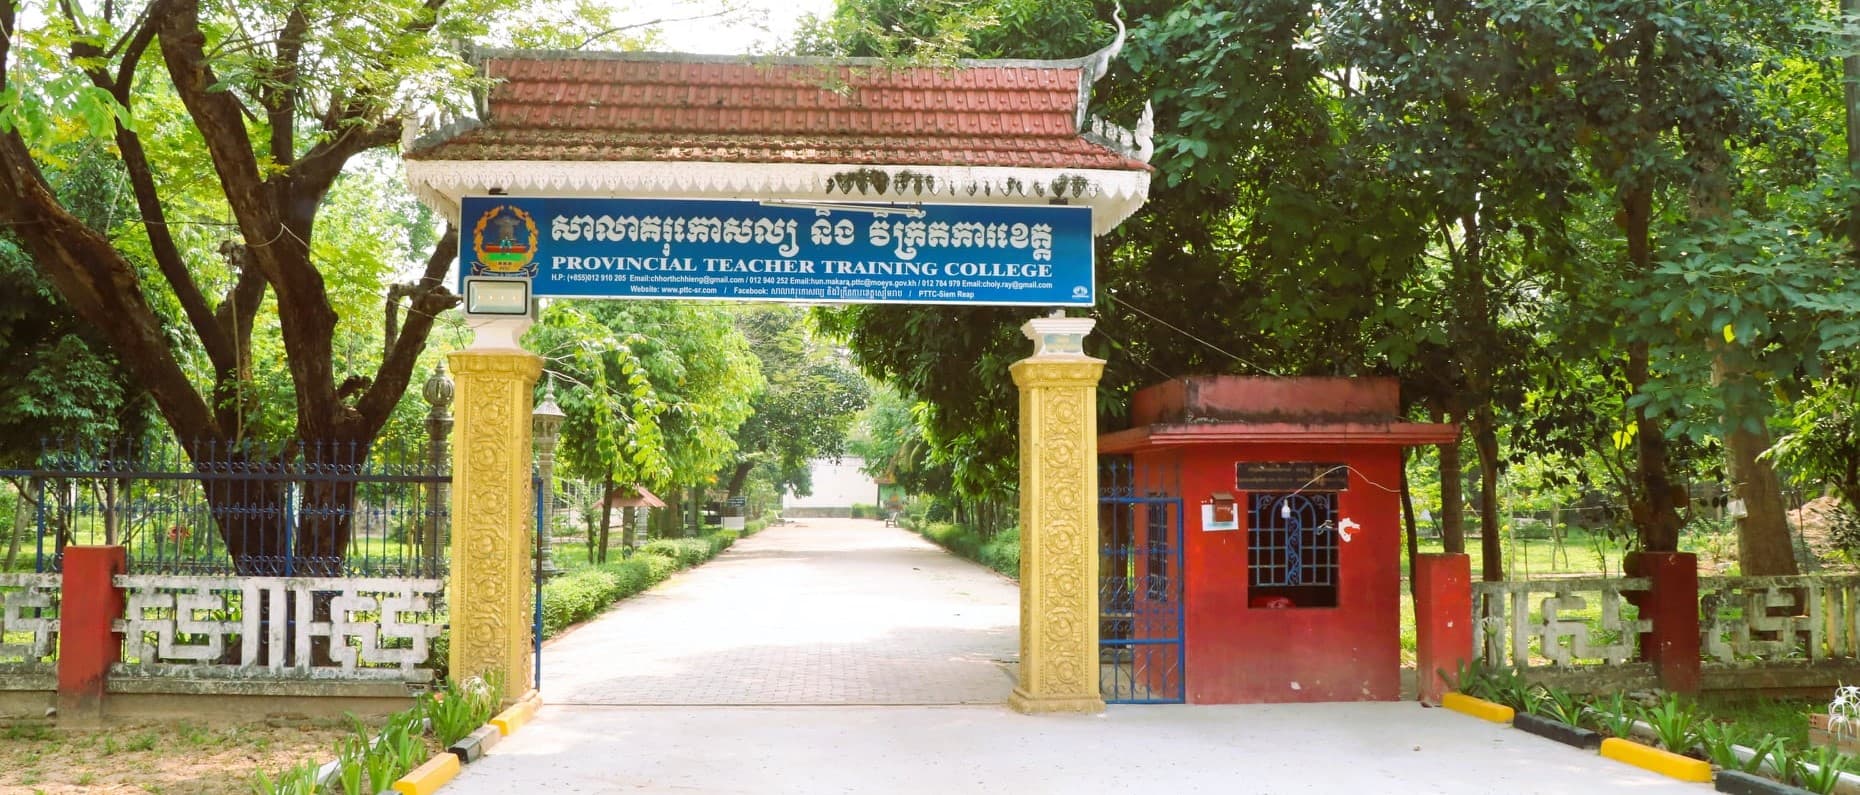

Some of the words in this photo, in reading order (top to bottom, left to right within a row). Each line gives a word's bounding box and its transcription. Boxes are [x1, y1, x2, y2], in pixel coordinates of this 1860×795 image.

[811, 207, 855, 246] និង
[551, 256, 696, 272] PROVINCIAL
[703, 259, 815, 275] TEACHER
[822, 260, 938, 276] TRAINING
[945, 263, 1053, 278] COLLEGE
[551, 273, 566, 282] H.P:
[600, 274, 613, 282] 910
[614, 274, 627, 282] 205
[749, 276, 762, 285] 012
[776, 276, 789, 285] 252
[921, 279, 935, 287] 012
[630, 285, 660, 294] Website:
[661, 286, 717, 296] www.pttc-sr.com
[733, 287, 768, 296] Facebook:
[918, 290, 957, 299] PTTC-Siem
[958, 291, 975, 300] Reap
